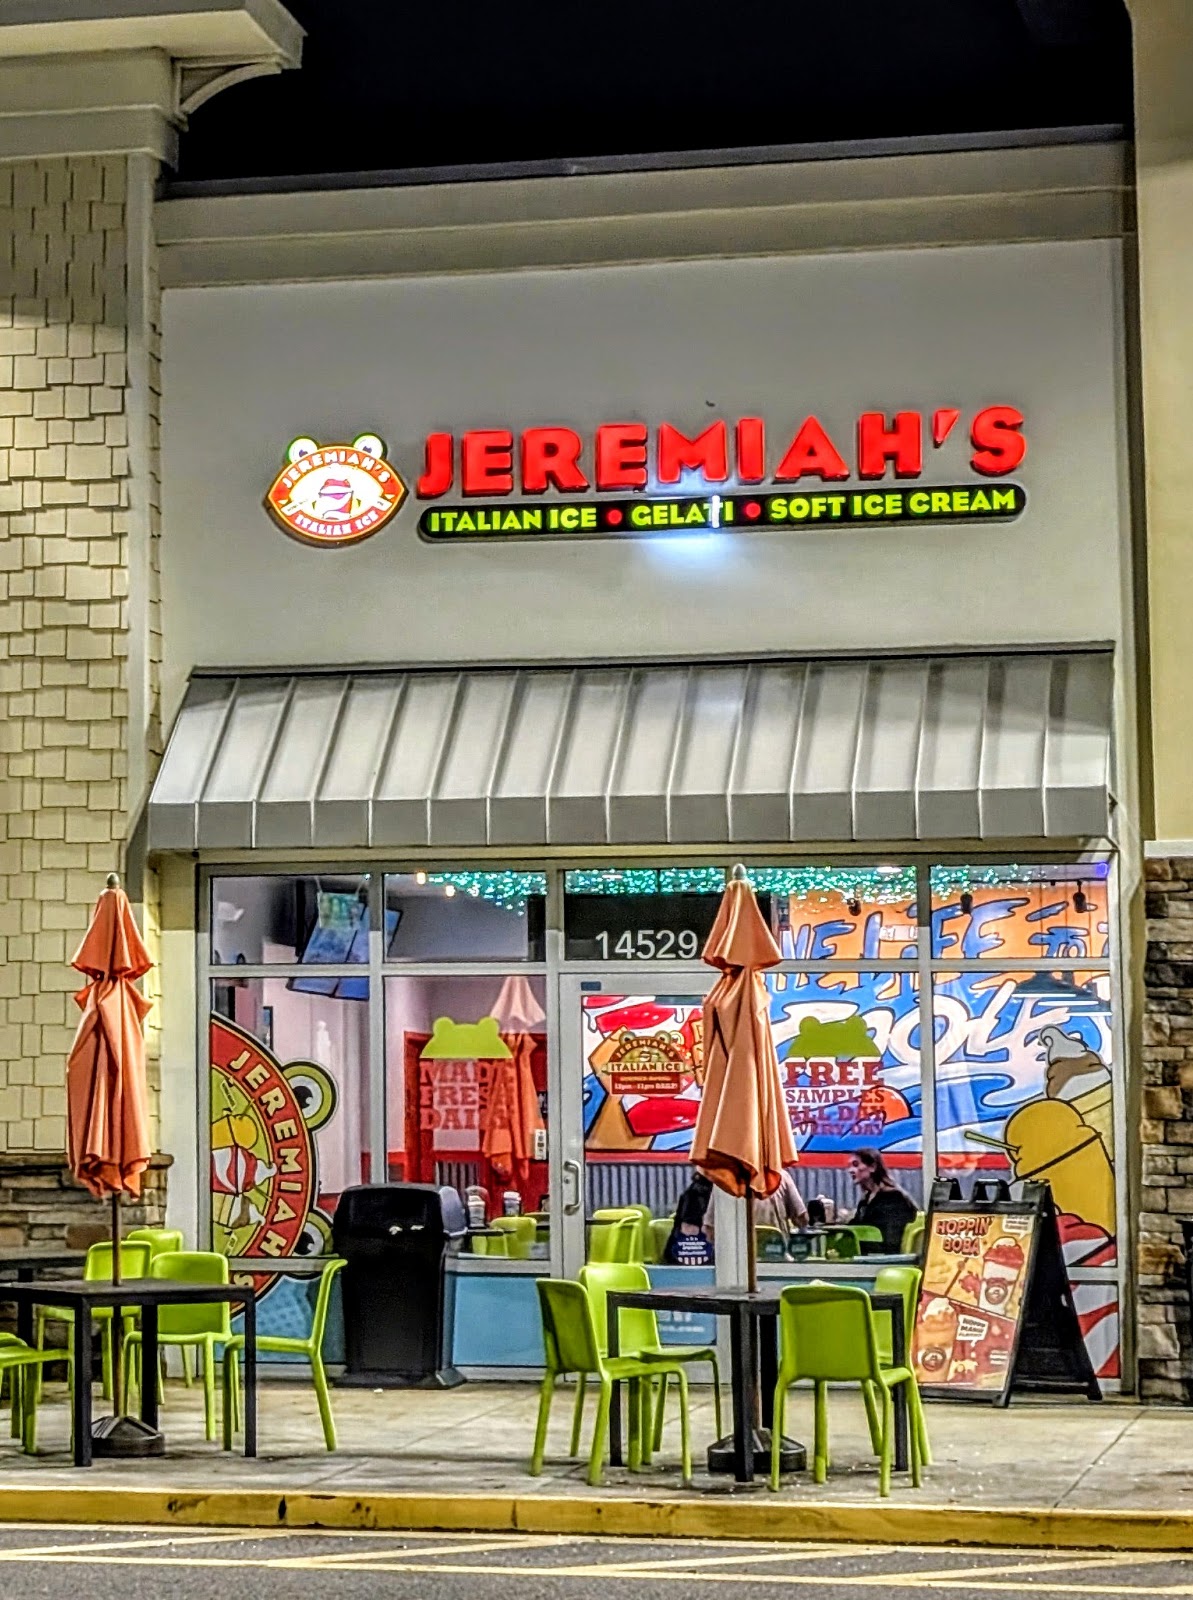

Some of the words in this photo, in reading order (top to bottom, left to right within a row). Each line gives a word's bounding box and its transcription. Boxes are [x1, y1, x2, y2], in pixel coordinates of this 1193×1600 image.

[417, 406, 1027, 498] JEREMIAH'S
[282, 450, 391, 489] JEREMIAH'S
[631, 500, 735, 526] GELATI
[770, 496, 846, 521] SOFT
[853, 493, 903, 516] ICE
[909, 489, 1017, 514] CREAM
[429, 507, 543, 532] ITALIAN
[548, 507, 598, 529] ICE
[595, 929, 698, 960] 14529
[615, 1039, 676, 1059] JEREMIAH'S
[611, 1062, 657, 1072] ITALIAN
[661, 1062, 681, 1072] ICE
[783, 1061, 885, 1089] FREE
[785, 1089, 885, 1104] SAMPLES
[792, 1122, 845, 1136] VERY
[936, 1215, 995, 1236] HOPPIN'
[943, 1236, 981, 1256] BOBA
